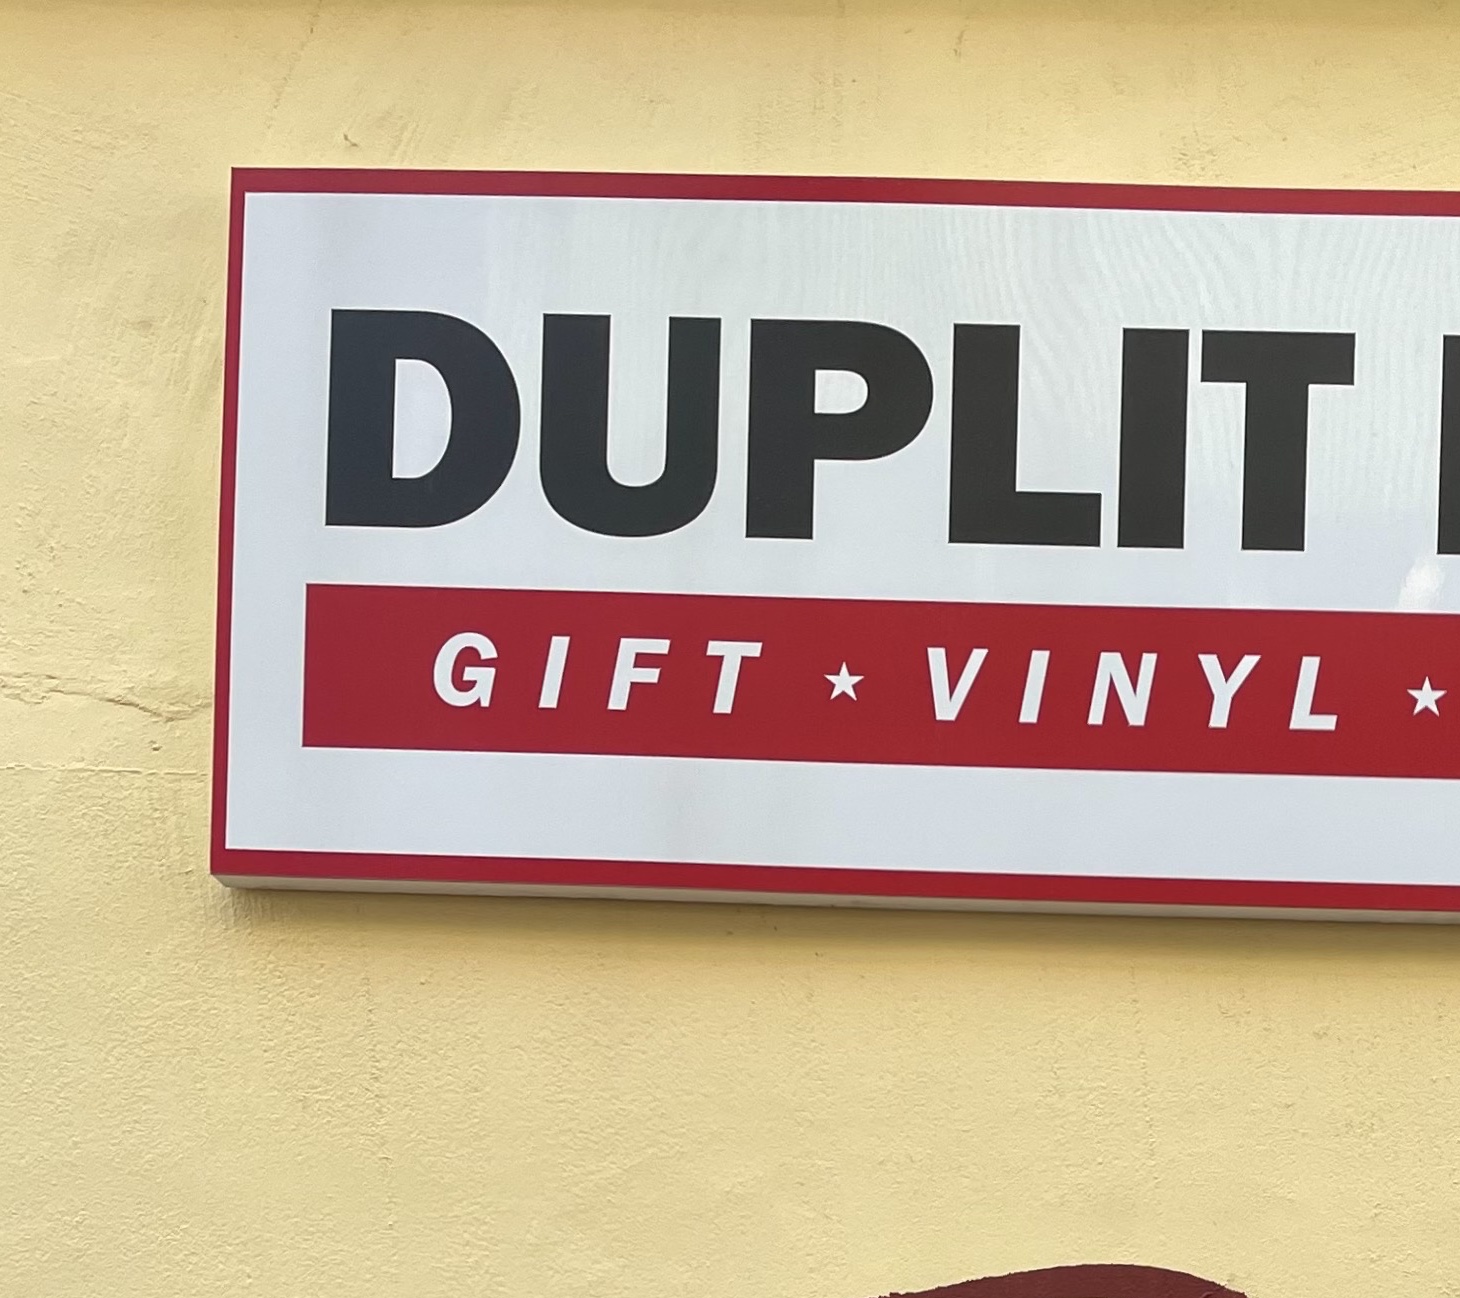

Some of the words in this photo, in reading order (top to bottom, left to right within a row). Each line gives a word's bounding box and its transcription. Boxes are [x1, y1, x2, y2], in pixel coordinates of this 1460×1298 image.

[325, 308, 1356, 552] DUPLIT
[433, 632, 763, 714] GIFT
[927, 647, 1338, 731] VINYL
